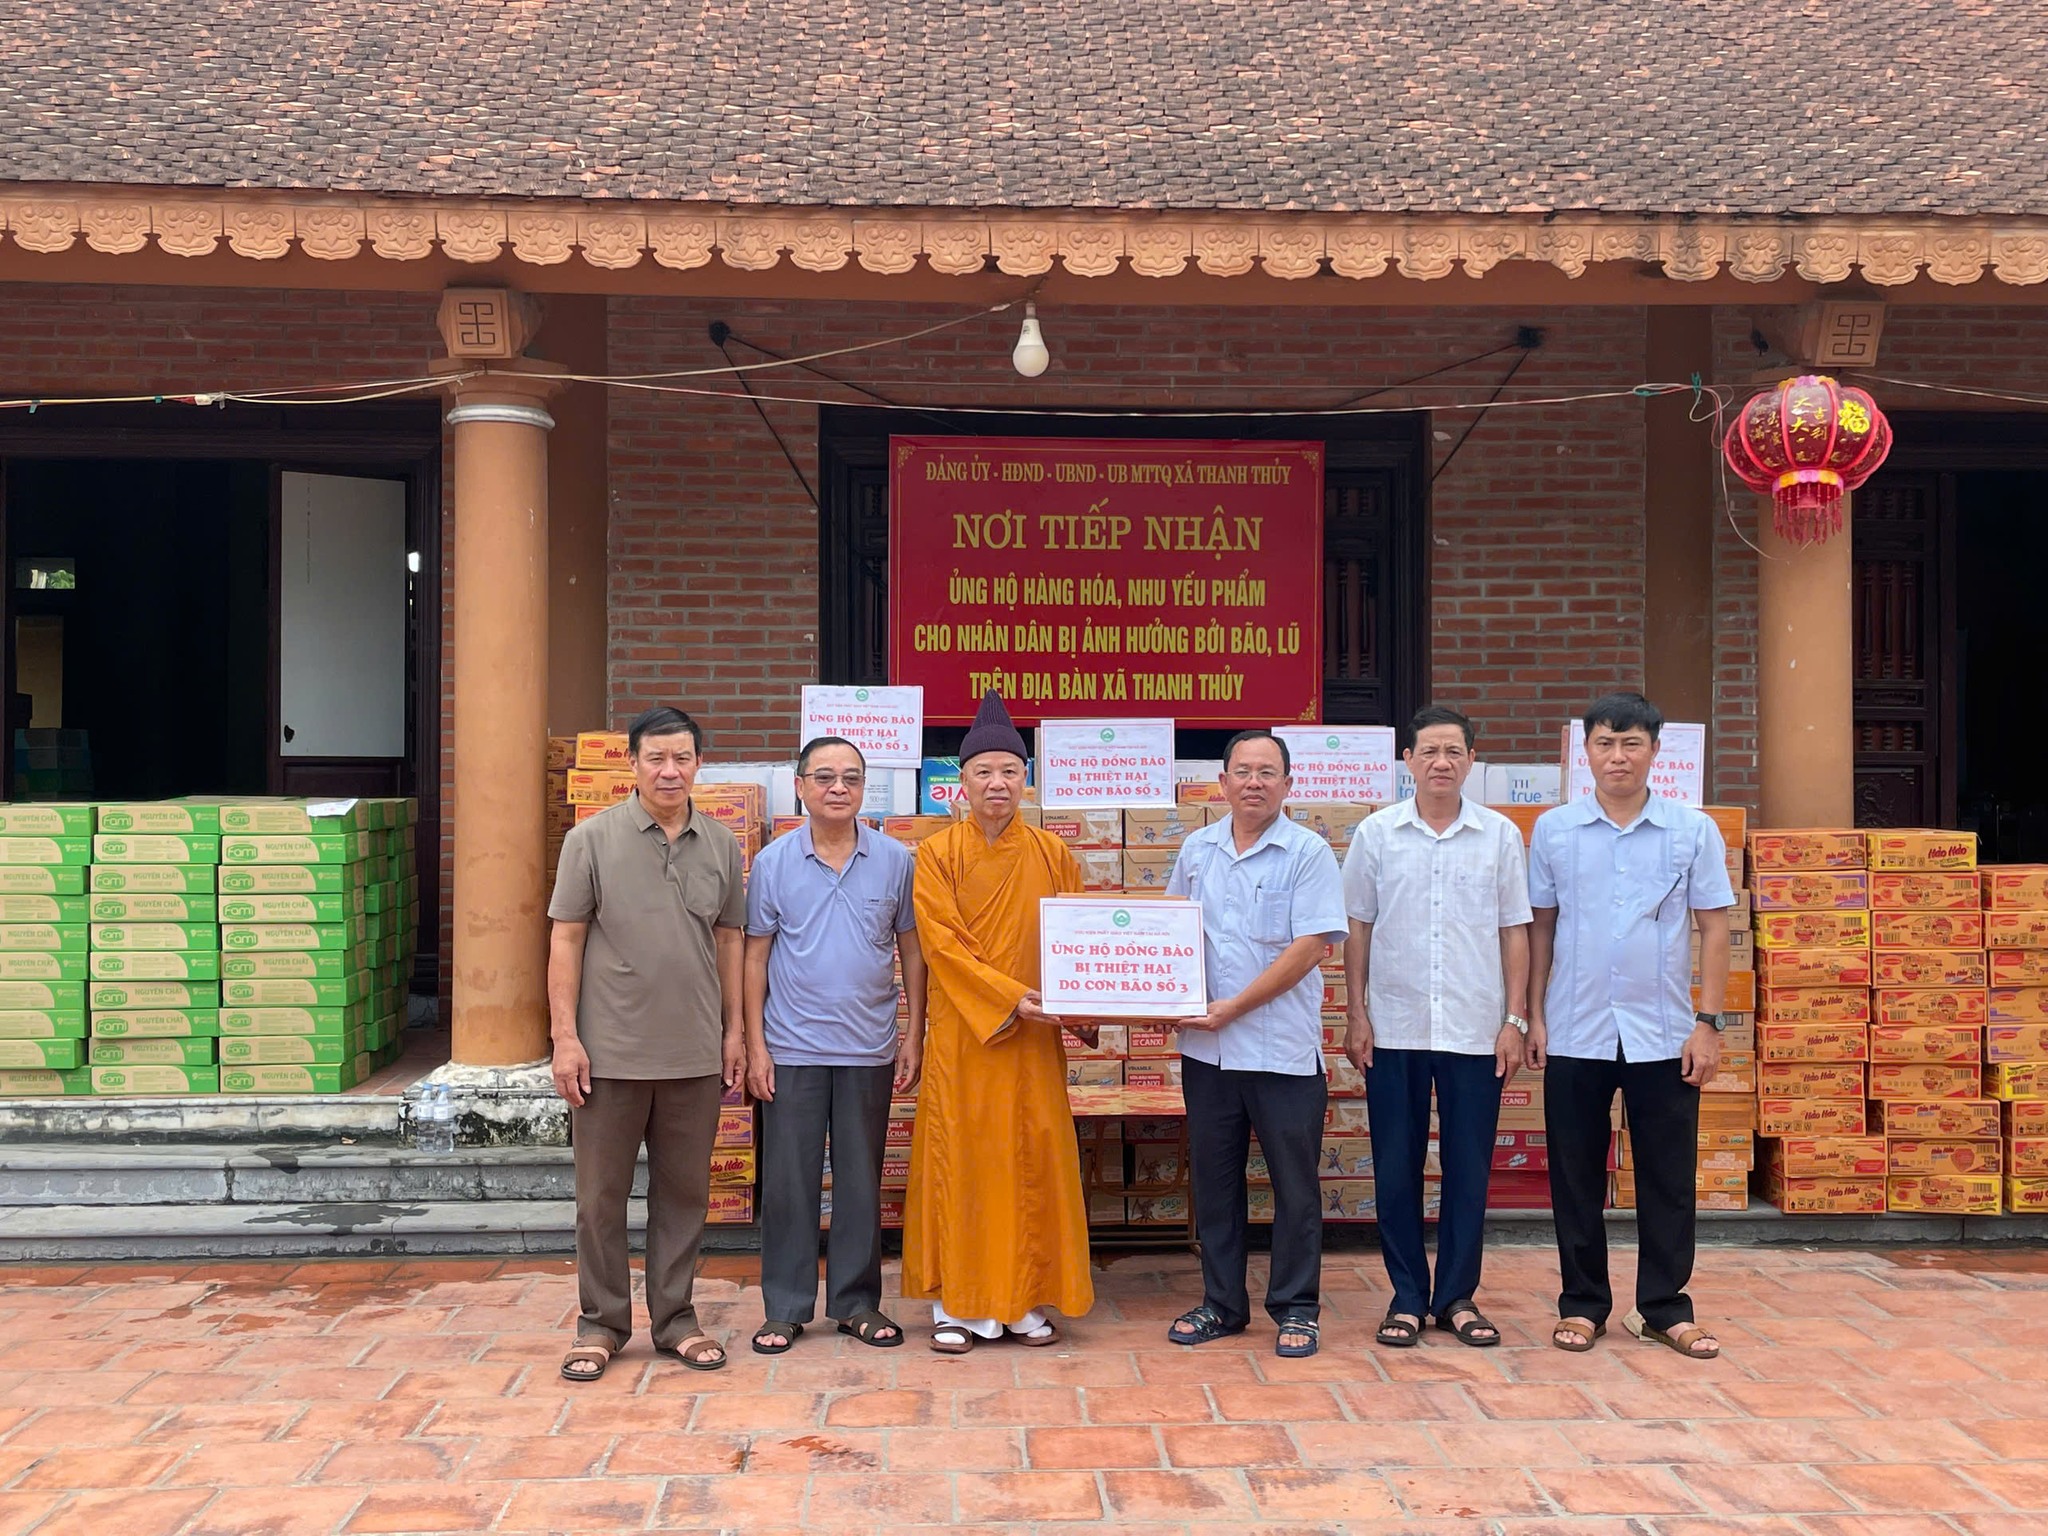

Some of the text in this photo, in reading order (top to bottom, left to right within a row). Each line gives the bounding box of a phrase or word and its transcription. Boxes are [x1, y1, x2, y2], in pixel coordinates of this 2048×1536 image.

[1838, 400, 1870, 433] 福
[926, 454, 1291, 487] ĐẢNG ỦY HĐND UBND UB MTTQ XÃ THANH THỦY
[953, 498, 1263, 560] NƠI TIẾP NHẬN
[950, 569, 1265, 610] ỦNG HỘ HÀNG HÓA, NHU YẾU PHẨM
[915, 618, 1299, 658] CHO NHÂN DÂN BỊ ẢNH HƯỞNG BỞI BÃO, LŨ
[970, 665, 1244, 705] TRÊN ĐỊA BÀN XÃ THANH THỦY
[837, 713, 853, 724] HỘ
[826, 727, 897, 738] BỊ THIỆT HẠI
[860, 740, 882, 750] BÃO
[886, 740, 900, 750] SỐ
[1081, 756, 1098, 769] HỘ
[1290, 764, 1305, 772] NG
[1309, 762, 1324, 773] HỘ
[1649, 760, 1666, 770] NG
[1069, 771, 1148, 782] BỊ THIỆT HẠI
[1298, 775, 1370, 785] BỊ THIỆT HẠI
[1652, 775, 1675, 785] HẠI
[1056, 787, 1073, 796] DO
[1077, 786, 1103, 795] CƠN
[1106, 785, 1132, 795] BÃO
[1135, 783, 1150, 795] SỐ
[1512, 779, 1528, 789] TH
[1305, 790, 1328, 798] CƠN
[1332, 789, 1355, 798] BÃO
[1359, 787, 1373, 797] SỐ
[1512, 791, 1542, 803] true
[1662, 786, 1688, 799] SỐ 3
[1928, 844, 1967, 858] Hảo Hảo
[1089, 942, 1111, 958] HỘ
[1115, 941, 1158, 956] ĐỒNG
[1162, 944, 1194, 957] BÀO
[1075, 961, 1172, 976] BỊ THIỆT HẠI
[1059, 977, 1188, 992] DO CƠN BÃO SỐ 3
